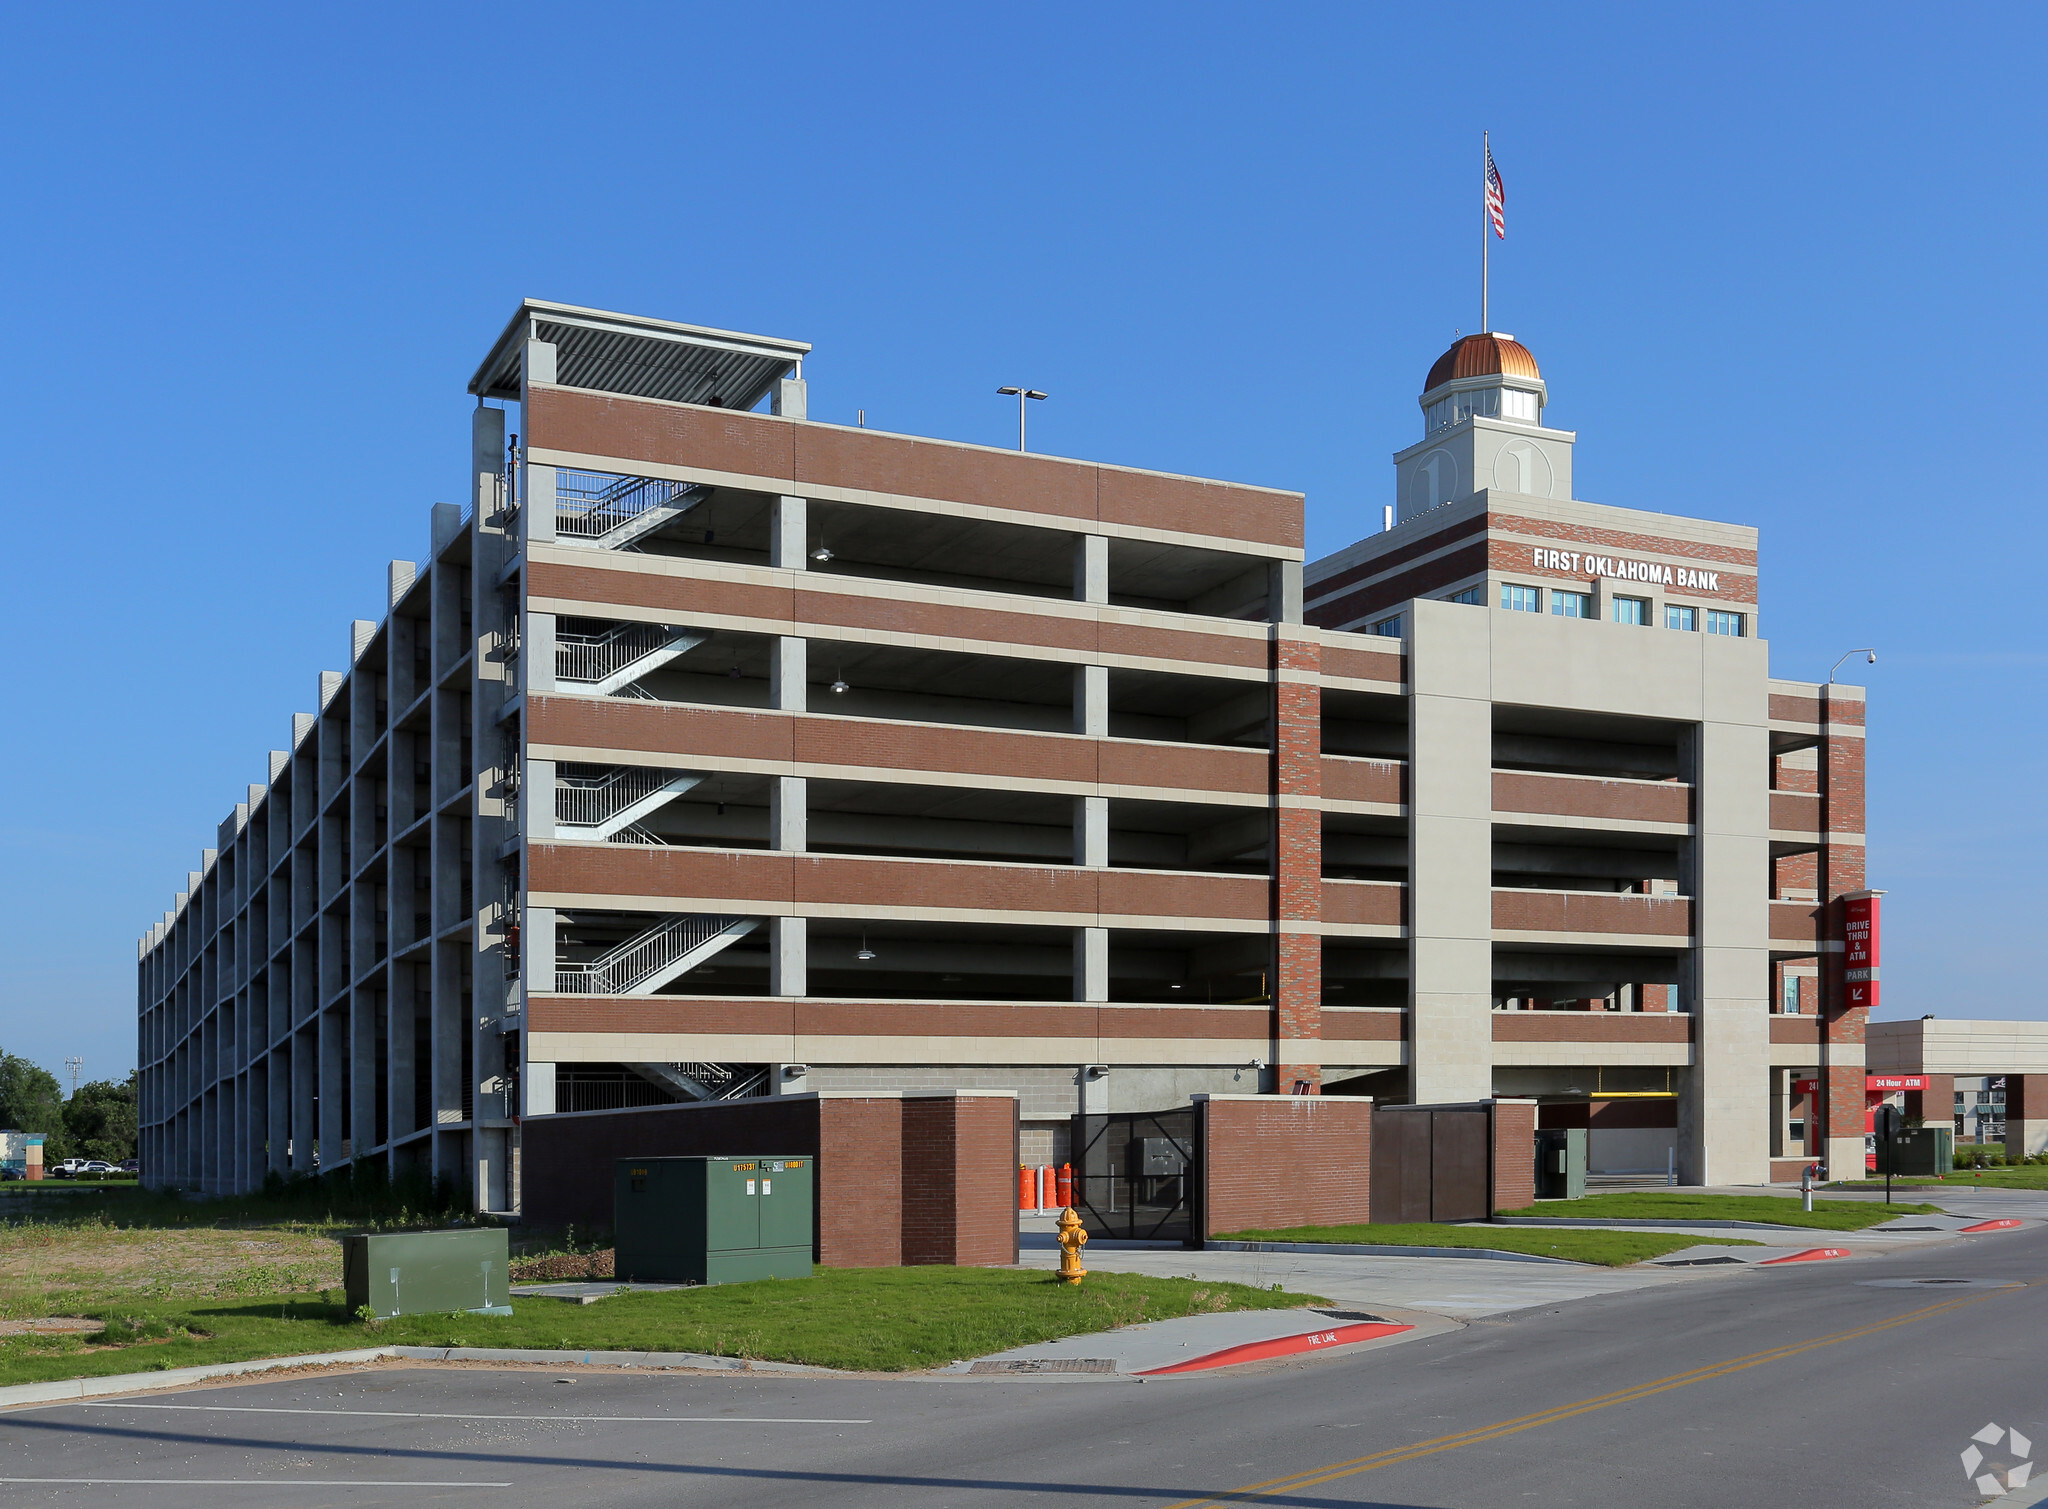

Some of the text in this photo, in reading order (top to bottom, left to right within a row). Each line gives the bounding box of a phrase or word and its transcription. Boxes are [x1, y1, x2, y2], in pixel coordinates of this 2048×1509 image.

[1533, 547, 1719, 592] FIRST OKLAHOMA BANK
[1846, 920, 1870, 932] DRIVE
[1847, 930, 1868, 941] THRU
[1854, 941, 1861, 951] &
[1849, 951, 1866, 961] ATM
[1847, 970, 1869, 980] PARK
[1808, 1081, 1817, 1091] 24
[1876, 1078, 1921, 1087] 24 Hour ATM
